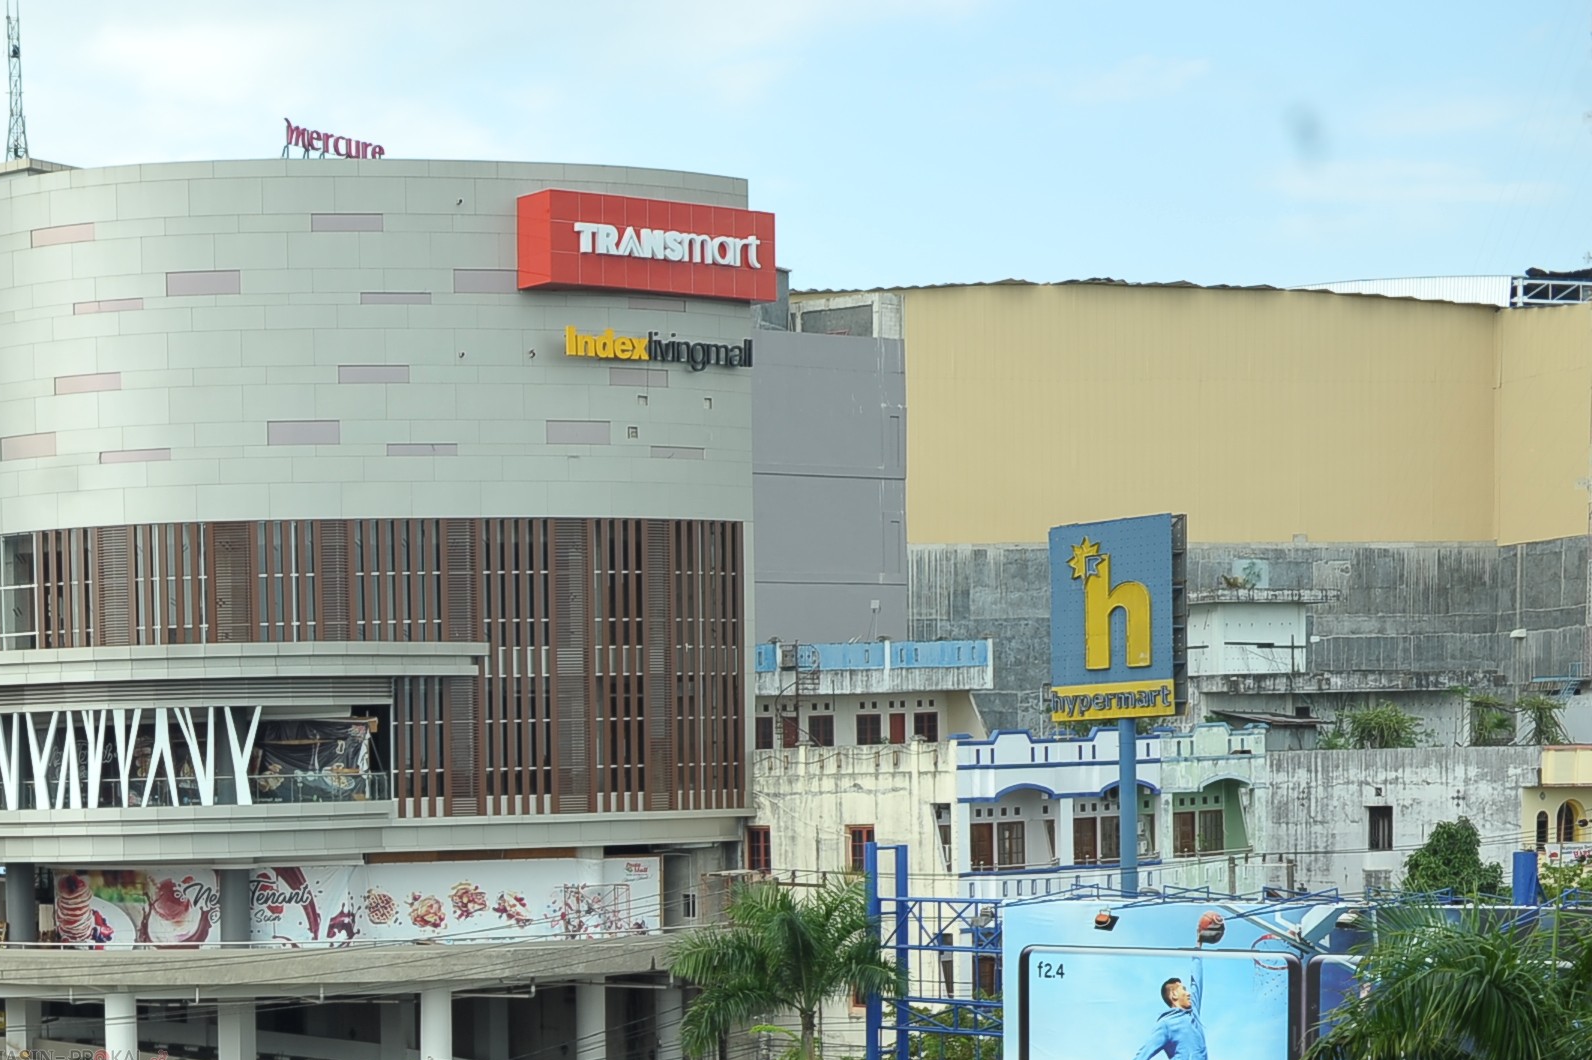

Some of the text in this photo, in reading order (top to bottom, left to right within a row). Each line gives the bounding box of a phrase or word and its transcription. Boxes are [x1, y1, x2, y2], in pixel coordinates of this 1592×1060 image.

[1052, 685, 1172, 717] hypermart
[183, 882, 220, 908] Ne
[1037, 961, 1065, 979] f2.4
